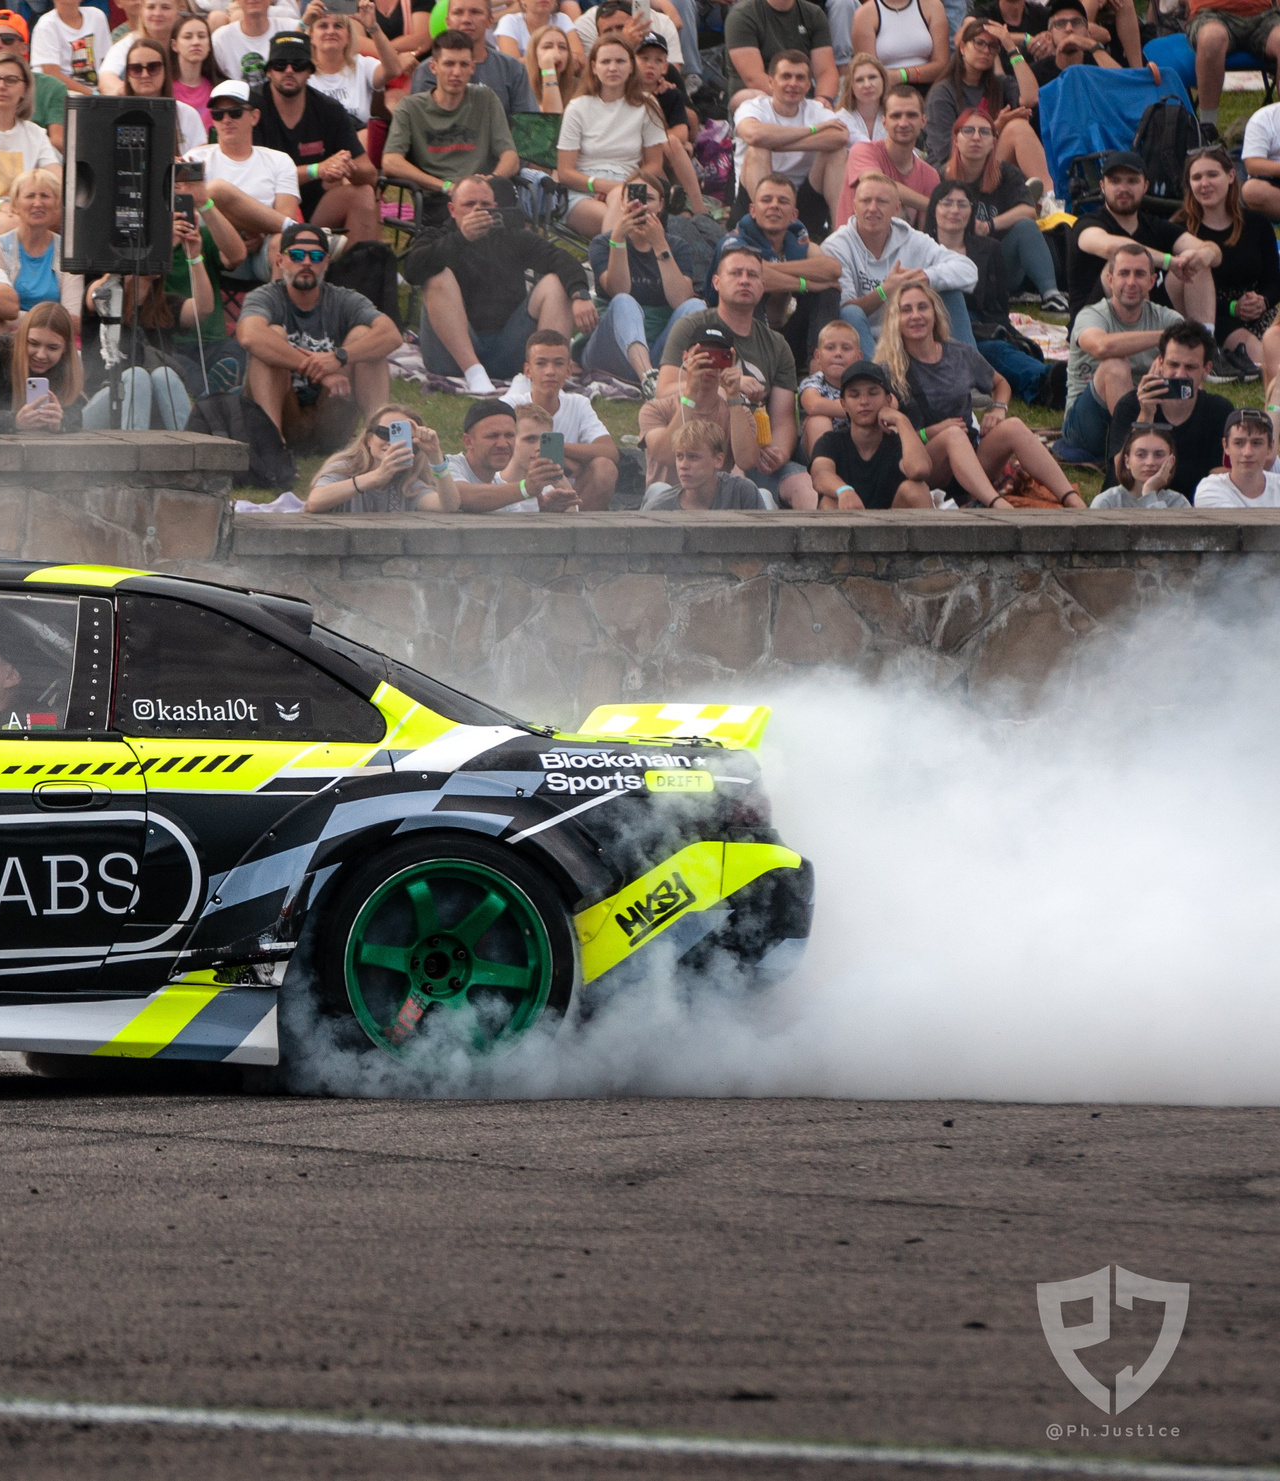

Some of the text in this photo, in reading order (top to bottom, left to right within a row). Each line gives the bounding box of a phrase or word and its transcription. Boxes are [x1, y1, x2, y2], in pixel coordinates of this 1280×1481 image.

[538, 753, 692, 769] Blockchain
[544, 771, 703, 794] Sports DRIFT
